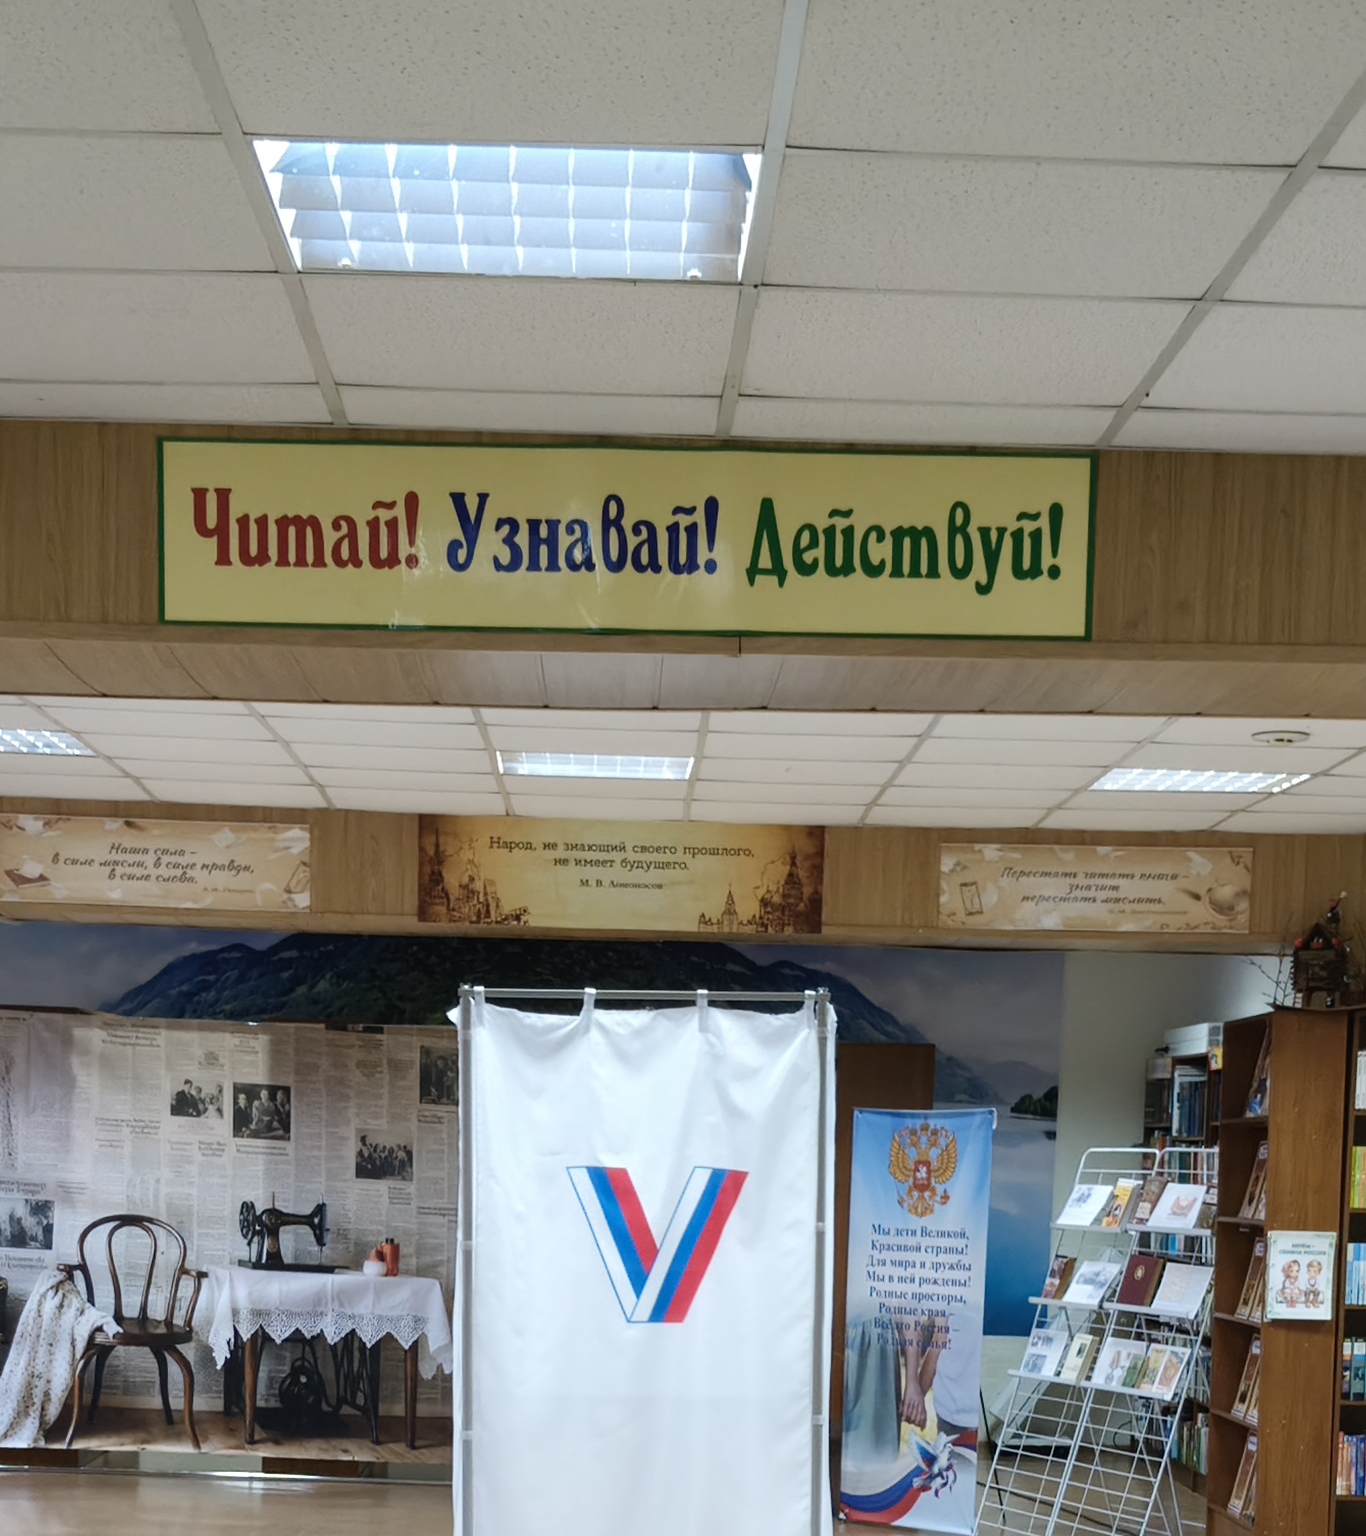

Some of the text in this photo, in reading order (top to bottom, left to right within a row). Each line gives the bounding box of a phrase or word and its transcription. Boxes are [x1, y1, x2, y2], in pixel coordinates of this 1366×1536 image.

[191, 486, 1065, 596] Читай! Узнавай! Действуй!
[108, 842, 149, 856] Наша
[153, 847, 186, 857] сила
[489, 836, 755, 858] Народ, не знающий своего прошлого,
[63, 856, 95, 868] силе
[553, 857, 569, 867] не
[574, 858, 615, 869] имеет
[871, 1223, 970, 1240] Мы дети Великой,
[871, 1239, 969, 1257] Красивой страны!
[866, 1254, 972, 1273] Для мира и дружбы
[866, 1270, 972, 1288] Мы в ней рождены!
[869, 1286, 967, 1306] Родные просторы,
[878, 1302, 919, 1316] Родные
[921, 1306, 947, 1319] края
